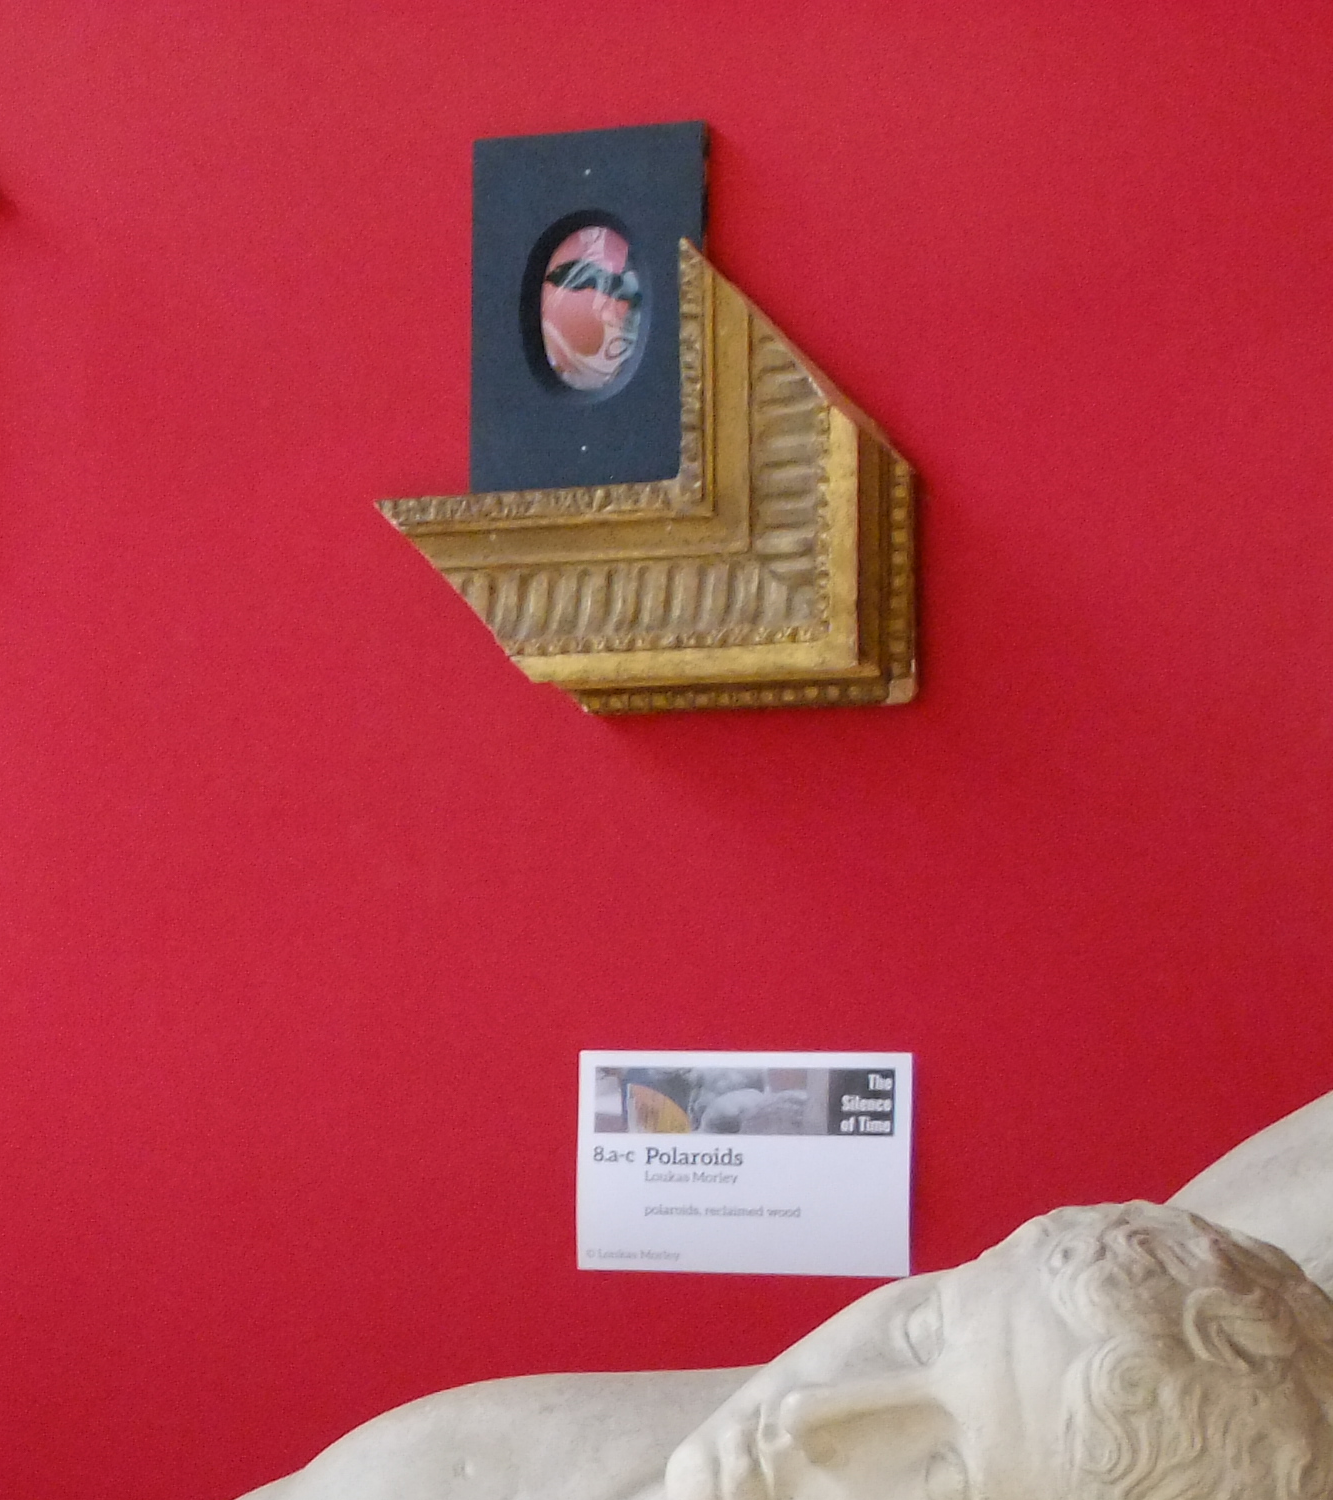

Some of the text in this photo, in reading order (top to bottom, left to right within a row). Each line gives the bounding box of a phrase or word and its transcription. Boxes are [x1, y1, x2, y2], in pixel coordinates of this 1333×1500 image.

[868, 1074, 892, 1090] The
[841, 1094, 892, 1111] Silence
[840, 1116, 891, 1132] of Time
[593, 1146, 744, 1166] 8.a-c Polaroids
[644, 1170, 690, 1183] Loukas
[766, 1206, 801, 1218] wood
